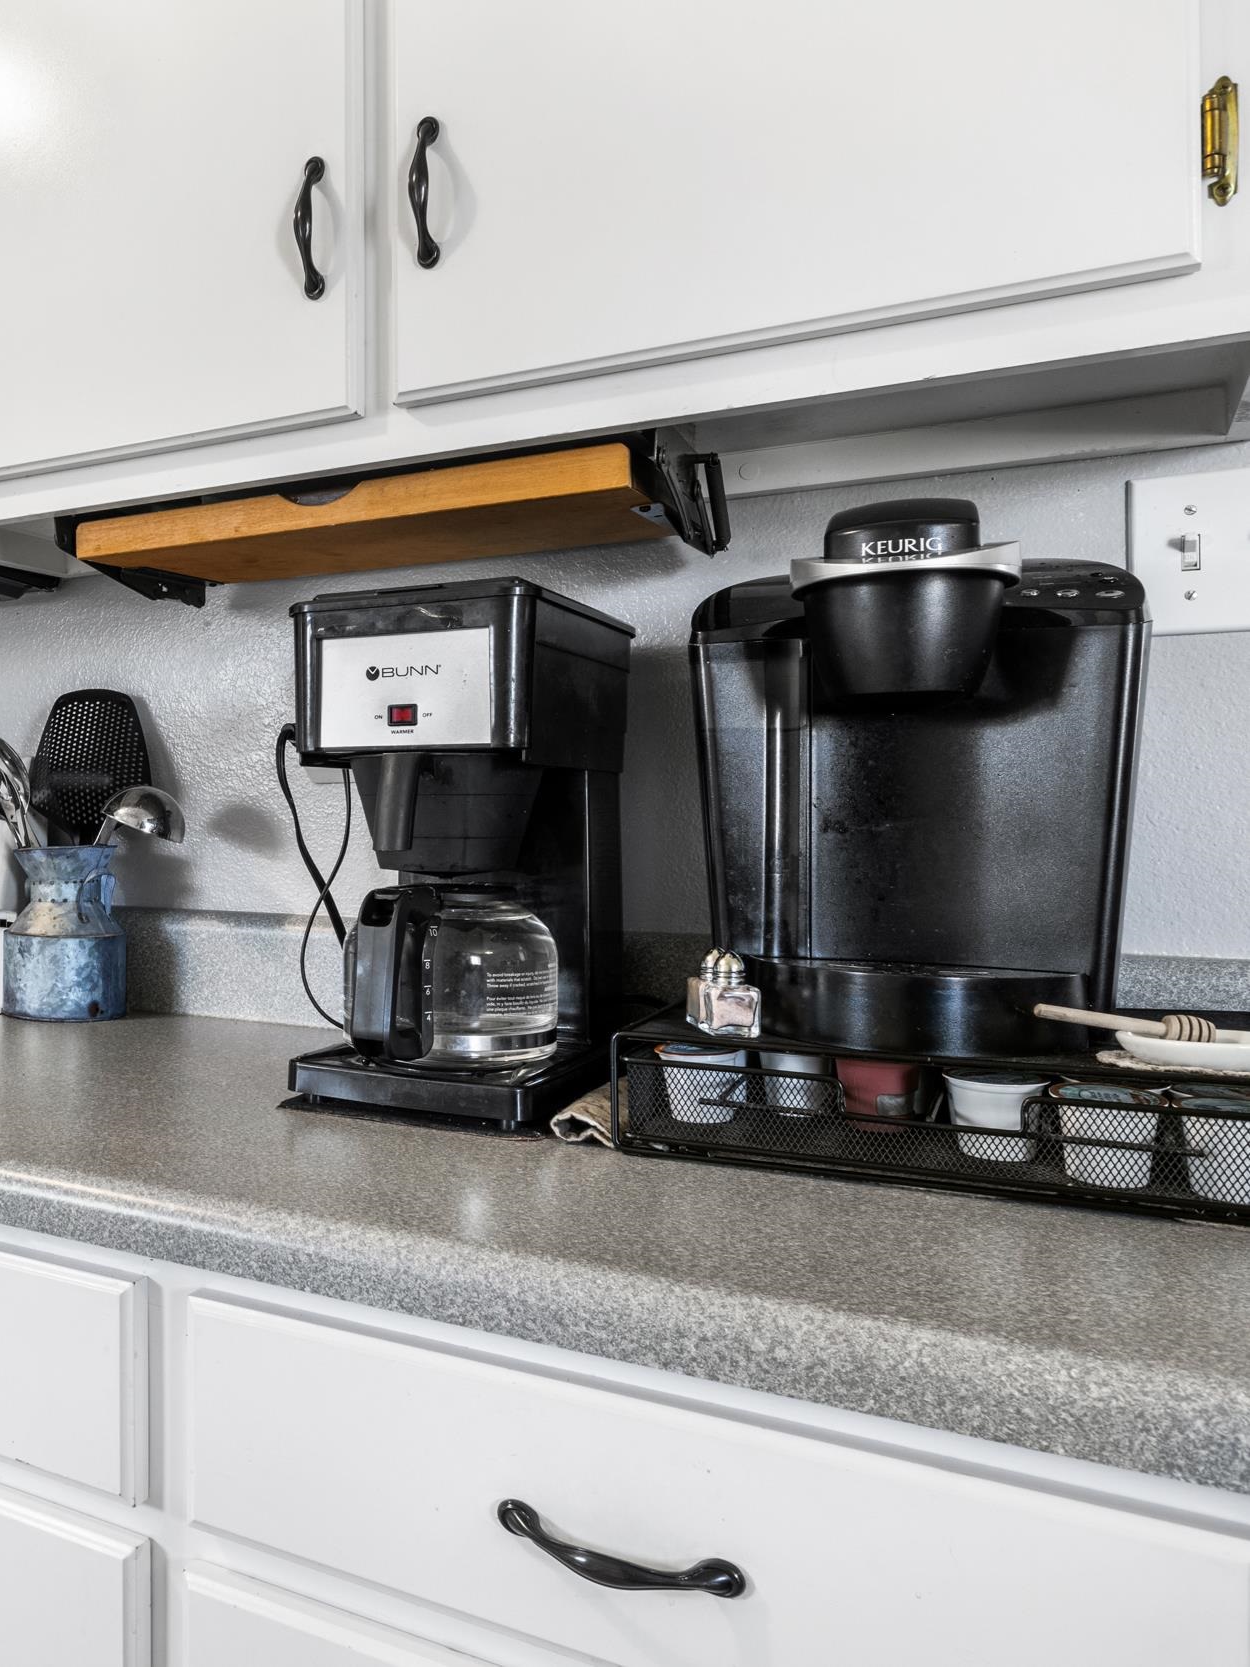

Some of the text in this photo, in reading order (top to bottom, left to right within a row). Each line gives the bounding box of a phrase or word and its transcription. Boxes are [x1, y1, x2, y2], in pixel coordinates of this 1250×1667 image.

[861, 537, 942, 557] KEURIG
[429, 928, 438, 936] 10
[425, 961, 430, 970] 8
[426, 988, 430, 996] 6
